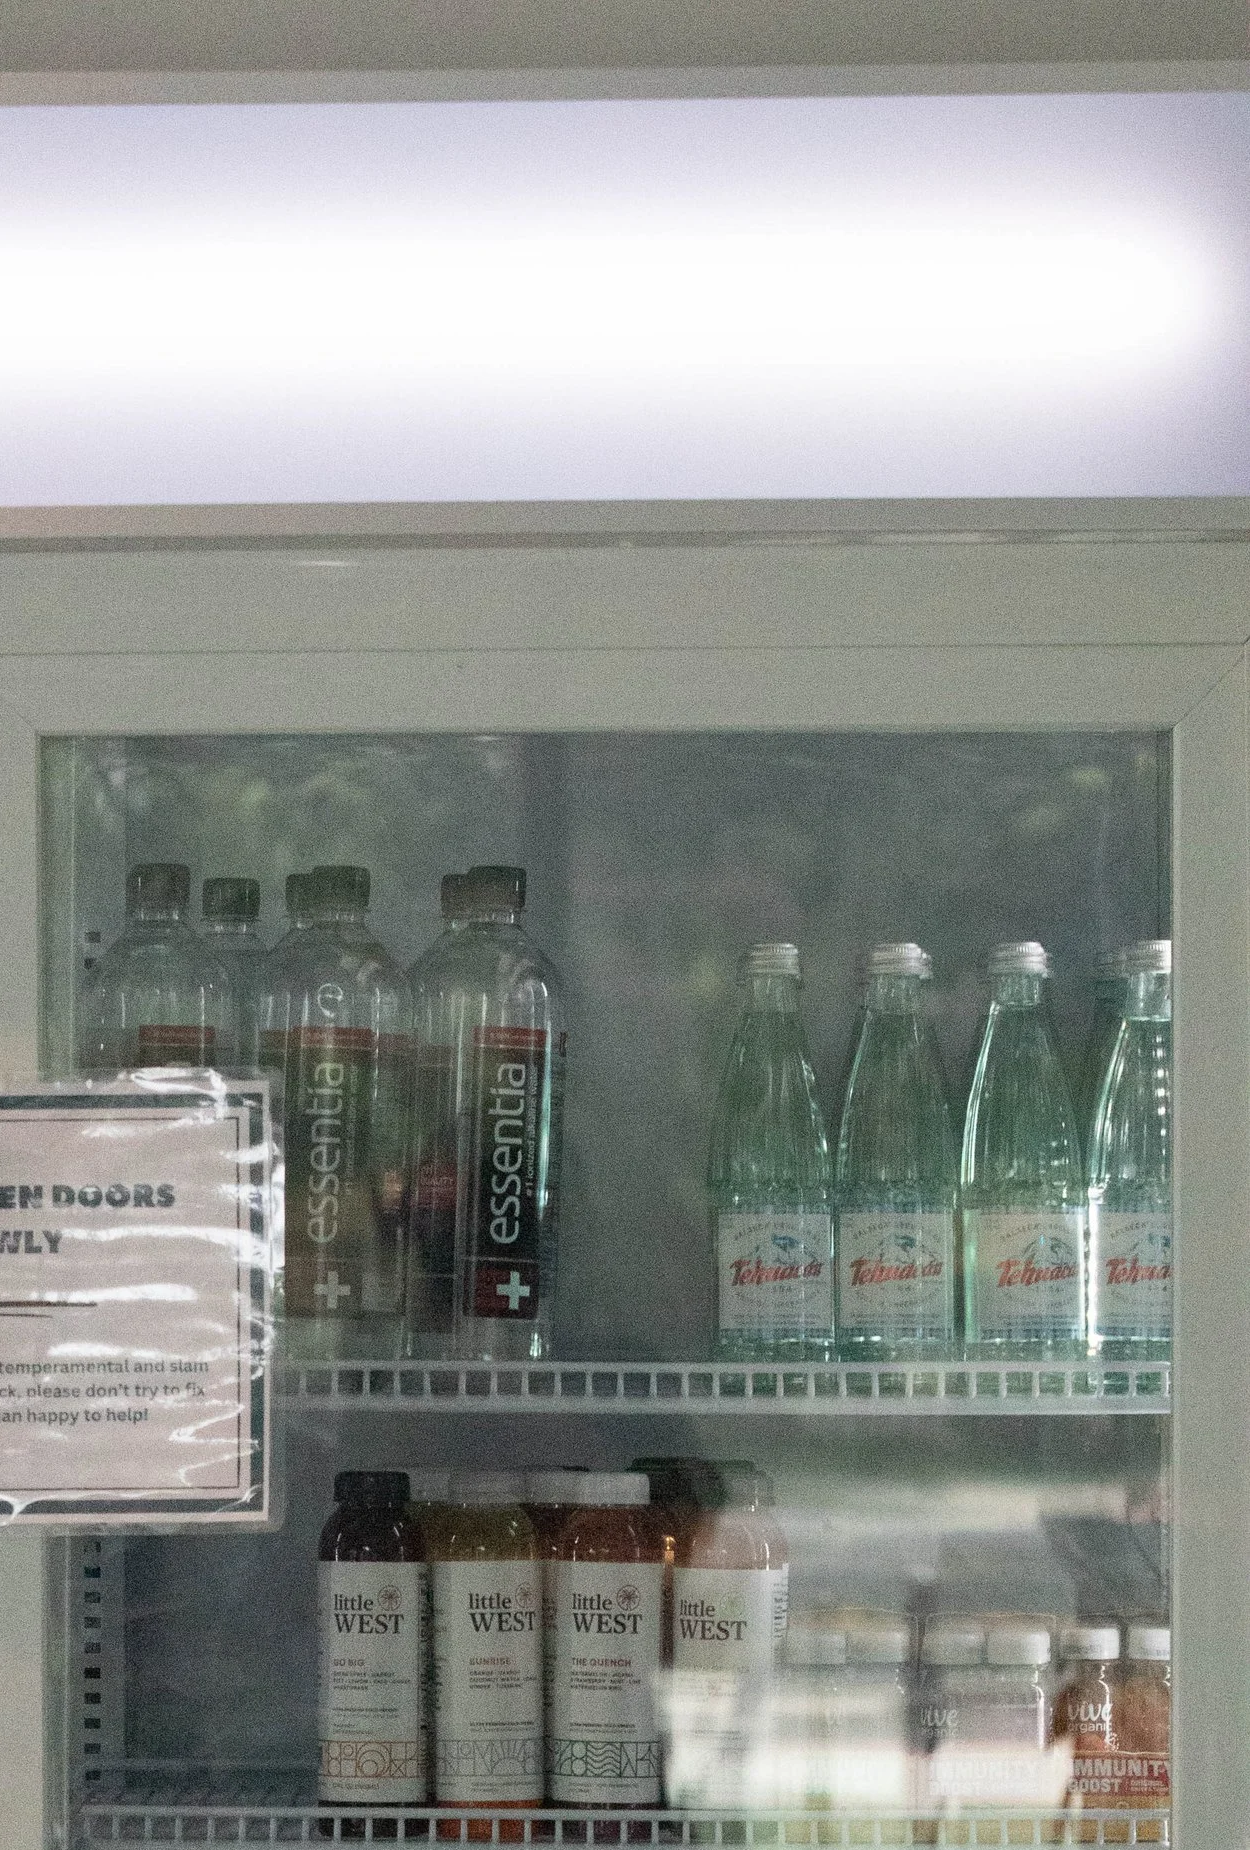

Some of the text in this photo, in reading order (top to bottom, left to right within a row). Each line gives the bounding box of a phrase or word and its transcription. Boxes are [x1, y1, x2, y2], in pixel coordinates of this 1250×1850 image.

[306, 1061, 345, 1244] essentia
[489, 1062, 526, 1243] essentia
[52, 1184, 175, 1208] DOORS
[0, 1360, 128, 1376] temperamental
[134, 1360, 165, 1373] and
[170, 1360, 209, 1373] slam
[26, 1385, 80, 1400] please
[86, 1383, 129, 1397] don't
[134, 1384, 159, 1401] try
[164, 1385, 180, 1396] to
[185, 1383, 205, 1397] fix
[27, 1409, 79, 1425] happy
[85, 1409, 101, 1422] to
[106, 1407, 150, 1425] help!
[333, 1592, 375, 1611] little
[469, 1591, 512, 1610] little
[572, 1592, 613, 1611] little
[680, 1600, 716, 1618] little
[334, 1613, 405, 1635] WEST
[469, 1611, 537, 1633] WEST
[573, 1612, 643, 1635] WEST
[680, 1619, 748, 1642] WEST
[469, 1657, 511, 1666] SUNRISE
[571, 1657, 632, 1668] THE QUENCH
[1068, 1701, 1113, 1721] vive
